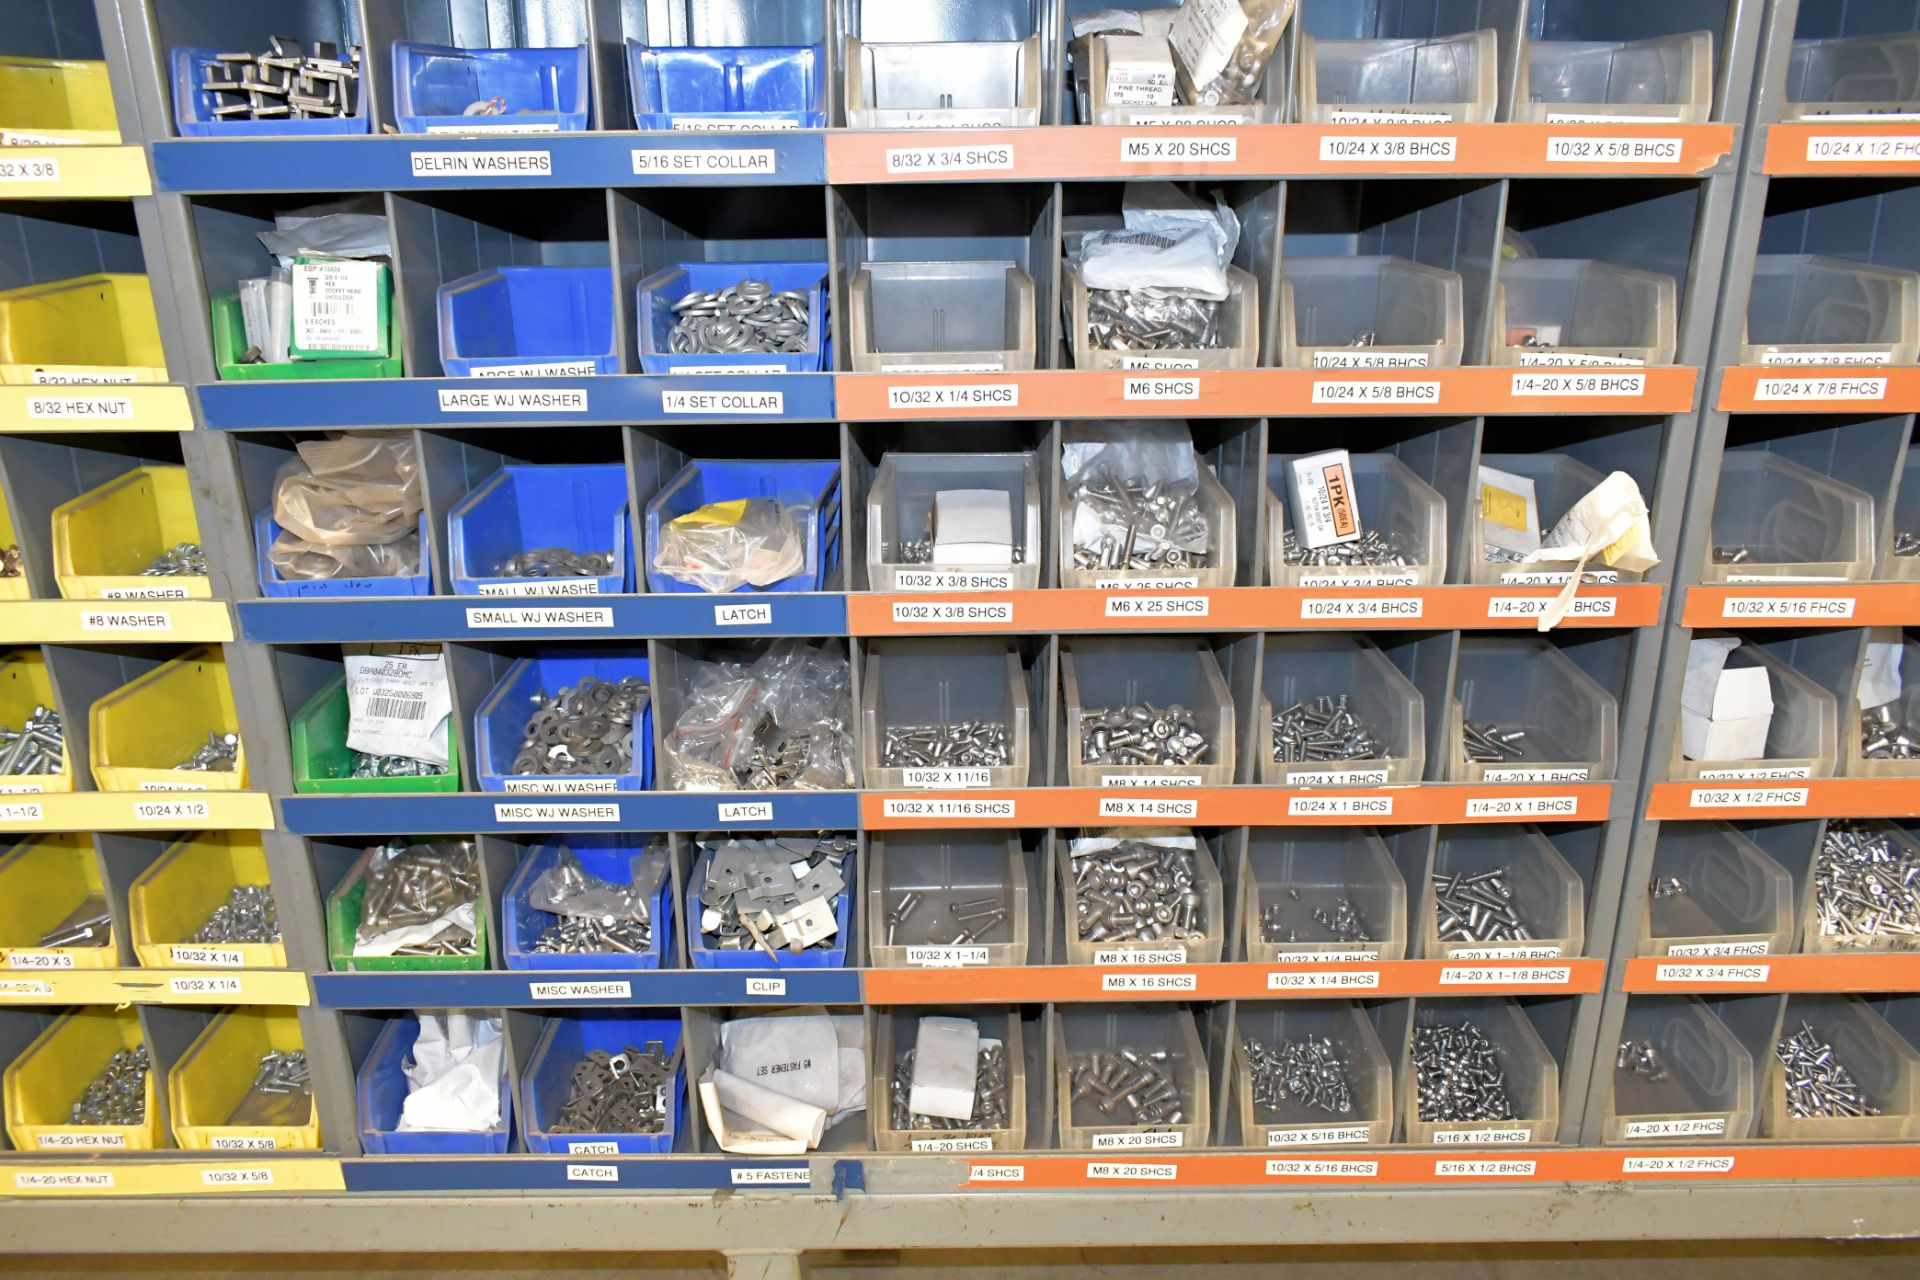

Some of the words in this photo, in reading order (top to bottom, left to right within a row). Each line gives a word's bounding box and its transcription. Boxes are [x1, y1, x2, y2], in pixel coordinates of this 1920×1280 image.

[1128, 142, 1150, 156] M5
[1154, 143, 1163, 156] X
[1168, 142, 1185, 156] 20
[1189, 142, 1230, 156] SHCS
[1329, 141, 1365, 155] 10/24
[1370, 142, 1380, 155] X
[1384, 141, 1405, 155] 3/8
[1409, 142, 1450, 156] BHCS
[1555, 142, 1590, 156] 10/32
[1594, 143, 1604, 156] X
[1608, 142, 1630, 156] 5/8
[1634, 143, 1675, 157] BHCS
[413, 157, 468, 170] DELRIN
[472, 156, 549, 170] WASHERS
[639, 155, 669, 169] 5/16
[673, 155, 704, 169] SET
[707, 154, 768, 169] COLLAR
[892, 154, 921, 168] 8/32
[927, 153, 937, 166] X
[940, 153, 962, 166] 3/4
[966, 151, 1008, 164] SHCS
[1130, 382, 1150, 395] M6
[1154, 382, 1193, 395] SHCS
[1516, 378, 1559, 391] 1/4-20
[1562, 378, 1572, 391] X
[1575, 378, 1596, 391] 5/8
[1600, 378, 1639, 391] BHCS
[1765, 382, 1799, 396] 10/24
[1803, 383, 1813, 395] X
[1817, 382, 1837, 395] 7/8
[1840, 382, 1879, 395] FHCS
[935, 391, 944, 403] X
[950, 390, 969, 402] 1/4
[973, 389, 1012, 402] SHCS
[1320, 386, 1354, 398] 10/24
[1358, 386, 1368, 398] X
[1372, 386, 1392, 398] 5/8
[1396, 386, 1435, 398] BHCS
[442, 394, 489, 407] LARGE
[493, 394, 514, 407] WJ
[518, 394, 581, 407] WASHER
[666, 396, 685, 408] 1/4
[689, 395, 717, 408] SET
[721, 396, 778, 409] COLLAR
[33, 401, 62, 414] 8/32
[65, 402, 95, 414] HEX
[97, 402, 126, 414] NUT
[899, 575, 932, 586] 10/32
[935, 575, 944, 587] X
[948, 576, 968, 587] 3/8
[971, 576, 1008, 588] SHCS
[895, 606, 928, 618] 10/32
[932, 607, 941, 618] X
[945, 606, 965, 618] 3/8
[968, 606, 1006, 618] SHCS
[1112, 601, 1130, 612] M6
[1134, 601, 1143, 612] X
[1147, 600, 1163, 612] 25
[1166, 600, 1204, 612] SHCS
[1309, 603, 1341, 614] 10/24
[1346, 603, 1354, 614] X
[1358, 602, 1377, 614] 3/4
[1381, 601, 1418, 614] BHCS
[1731, 601, 1764, 613] 10/32
[1767, 602, 1776, 613] X
[1779, 601, 1807, 613] 5/16
[1810, 602, 1847, 614] FHCS
[473, 612, 518, 624] SMALL
[521, 612, 541, 623] WJ
[544, 611, 604, 623] WASHER
[722, 608, 766, 621] LATCH
[89, 615, 104, 626] #8
[107, 615, 166, 627] WASHER
[1698, 792, 1730, 803] 10/32
[1732, 793, 1741, 802] X
[1747, 792, 1763, 803] 1/2
[1766, 791, 1801, 802] FHCS
[139, 805, 171, 816] 10/24
[174, 805, 183, 815] X
[186, 804, 204, 815] 1/2
[724, 806, 766, 818] LATCH
[891, 803, 922, 813] 10/32
[926, 803, 934, 813] X
[939, 803, 971, 814] 11/16
[974, 803, 1010, 814] SHCS
[1105, 802, 1123, 813] M8
[1126, 803, 1135, 813] X
[1140, 803, 1153, 813] 14
[1157, 803, 1192, 814] SHCS
[1295, 801, 1325, 812] 10/24
[1329, 801, 1337, 811] X
[1352, 800, 1387, 811] BHCS
[1473, 802, 1511, 813] 1/4-20
[1514, 802, 1523, 812] X
[1537, 800, 1572, 811] BHCS
[500, 807, 533, 818] MISC
[536, 808, 555, 818] WJ
[558, 807, 614, 818] WASHER
[1446, 971, 1483, 980] 1/4-20
[1485, 971, 1493, 980] X
[1498, 970, 1529, 980] 1-1/8
[1531, 970, 1565, 980] BHCS
[1663, 968, 1693, 978] 10/32
[1695, 968, 1704, 977] X
[1706, 968, 1724, 978] 3/4
[1727, 968, 1761, 978] FHCS
[174, 980, 205, 990] 10/32
[208, 981, 216, 990] X
[219, 980, 237, 989] 1/4
[752, 981, 781, 991] CLIP
[1108, 977, 1126, 987] M8
[1129, 978, 1137, 987] X
[1142, 977, 1154, 987] 16
[1157, 977, 1192, 987] SHCS
[1275, 976, 1305, 986] 10/32
[1308, 976, 1316, 985] X
[1321, 976, 1337, 985] 1/4
[1341, 974, 1374, 985] BHCS
[536, 986, 567, 995] MISC
[570, 985, 624, 995] WASHER
[574, 1146, 615, 1155] CATCH
[1272, 1163, 1301, 1172] 10/32
[1303, 1164, 1311, 1172] X
[1314, 1164, 1338, 1173] 5/16
[1341, 1164, 1373, 1173] BHCS
[1441, 1163, 1465, 1172] 5/16
[1468, 1164, 1476, 1172] X
[1481, 1163, 1496, 1172] 1/2
[1499, 1163, 1531, 1173] BHCS
[1628, 1160, 1664, 1169] 1/4-20
[1666, 1160, 1674, 1169] X
[1679, 1160, 1695, 1169] 1/2
[1697, 1159, 1729, 1169] FHCS
[208, 1172, 238, 1182] 10/32
[240, 1173, 249, 1181] X
[251, 1171, 269, 1181] 5/8
[572, 1168, 613, 1177] CATCH
[1093, 1166, 1109, 1175] M8
[1112, 1167, 1120, 1175] X
[1123, 1167, 1138, 1175] 20
[1140, 1167, 1172, 1176] SHCS
